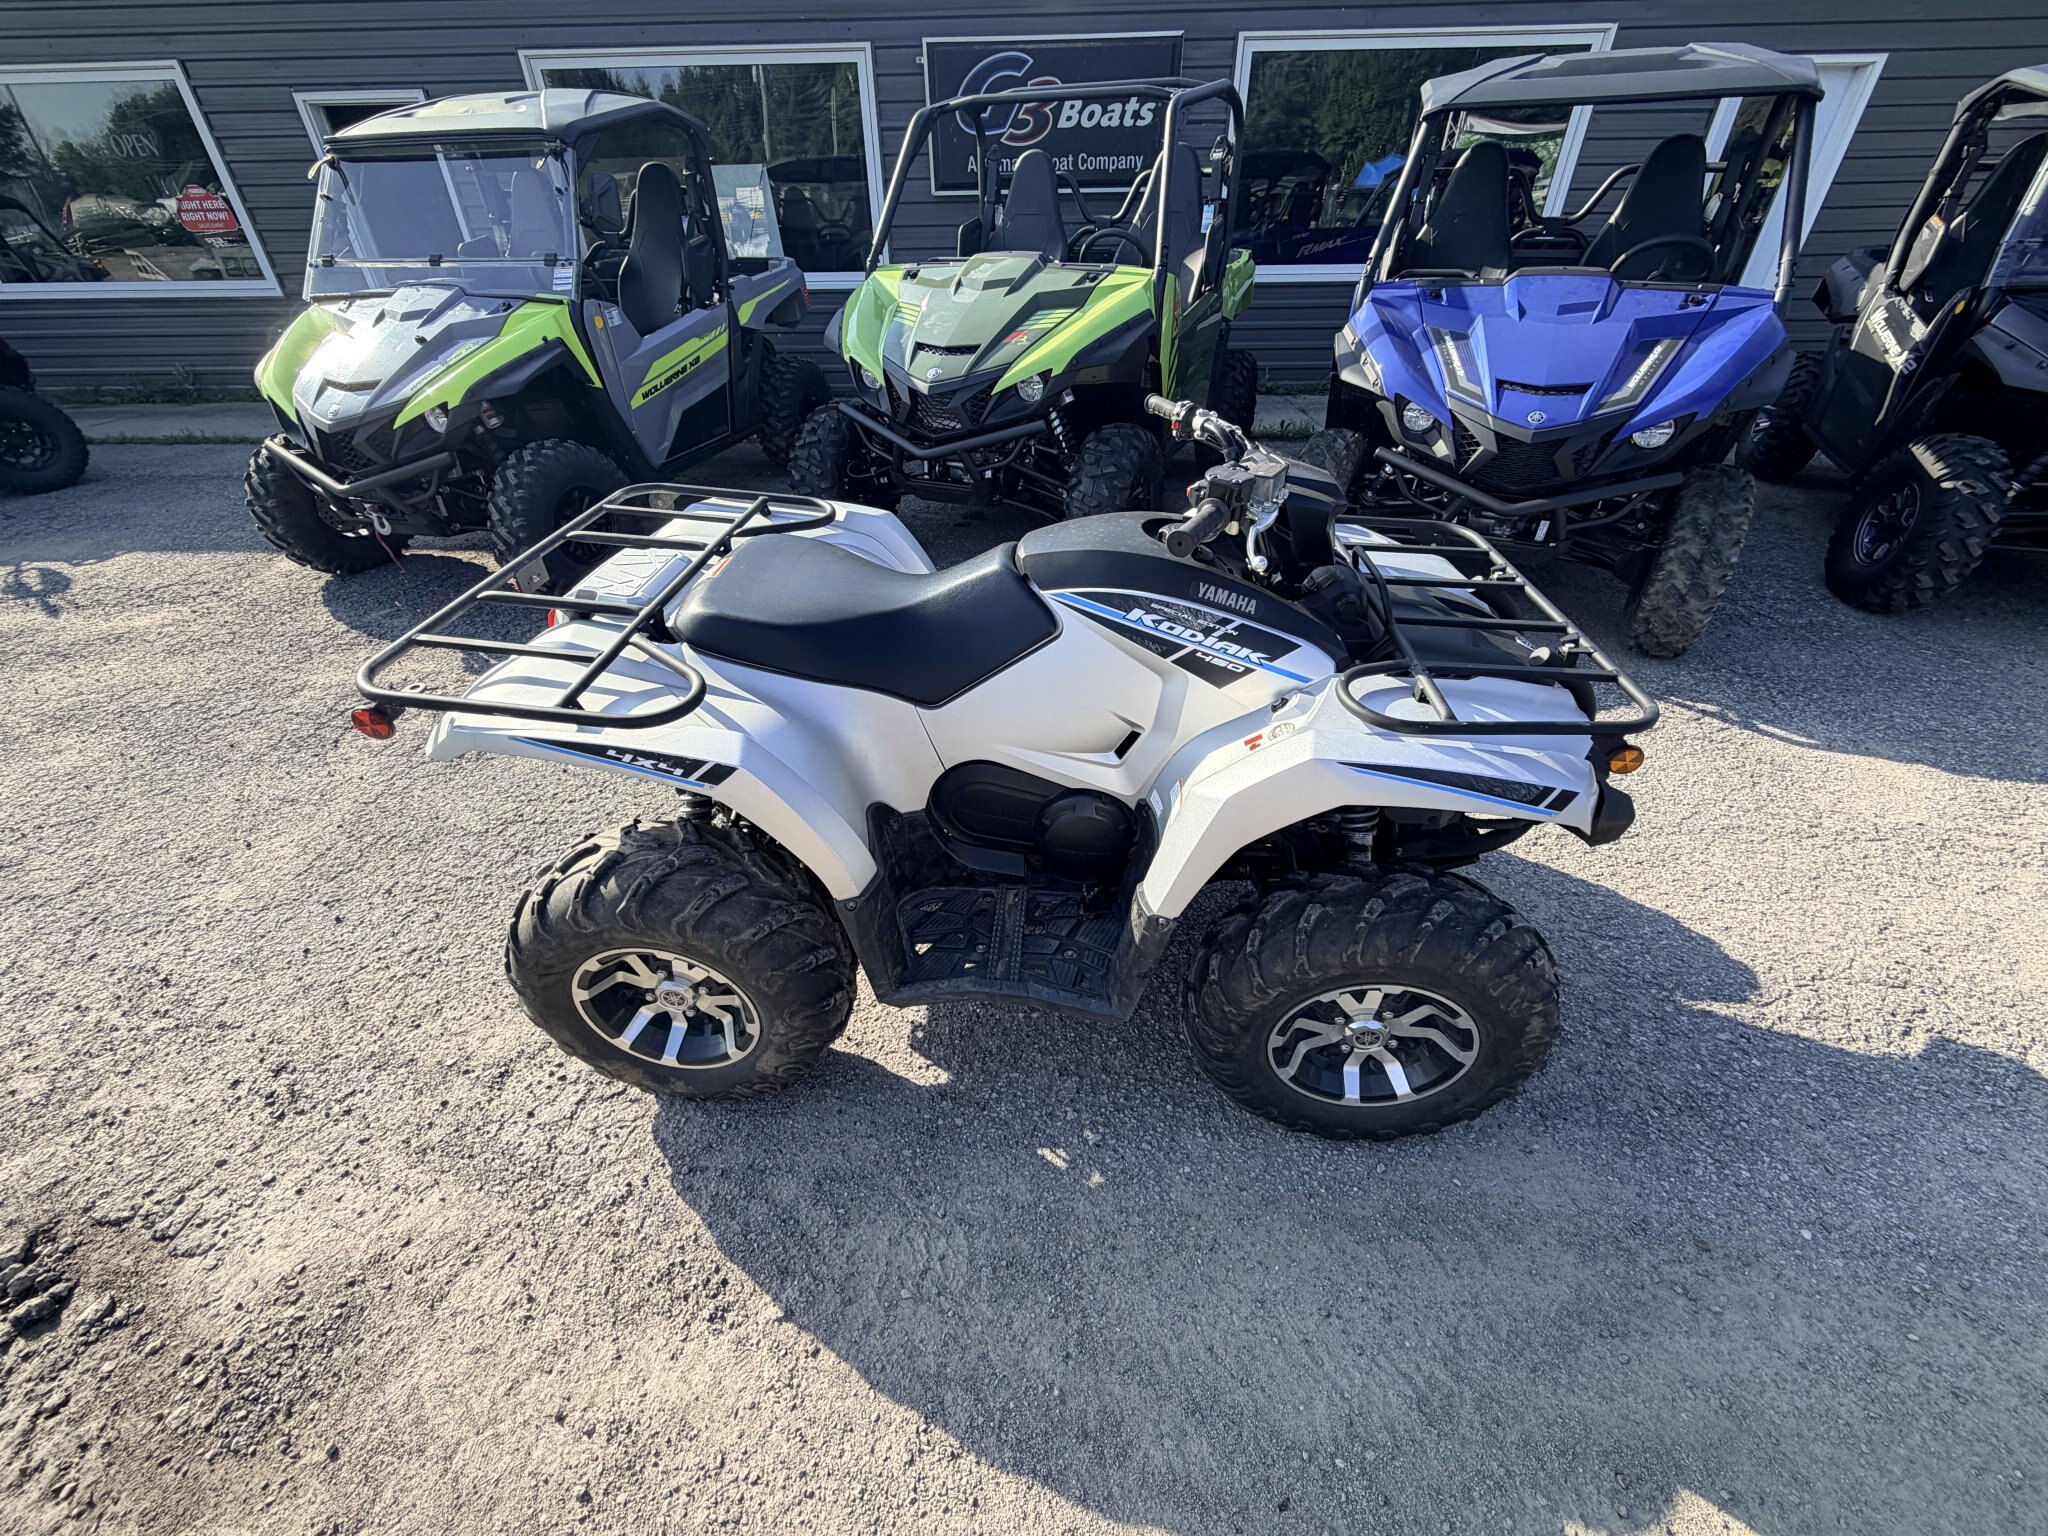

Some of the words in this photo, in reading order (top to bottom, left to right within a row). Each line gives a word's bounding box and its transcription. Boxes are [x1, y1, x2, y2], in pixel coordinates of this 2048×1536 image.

[956, 51, 1063, 147] G3
[1057, 97, 1156, 129] Boats
[110, 133, 160, 157] OPEN
[967, 155, 978, 173] A
[1078, 153, 1144, 174] Company
[181, 212, 205, 221] RIGHT
[206, 211, 230, 221] NOW!
[203, 200, 225, 209] HERE
[641, 364, 688, 400] WOLVERINE
[1639, 354, 1663, 386] UTILITY
[1198, 582, 1257, 615] YAMAHA
[1150, 603, 1196, 622] SPECIAL
[1197, 618, 1239, 636] EDITION
[1195, 651, 1246, 673] 450
